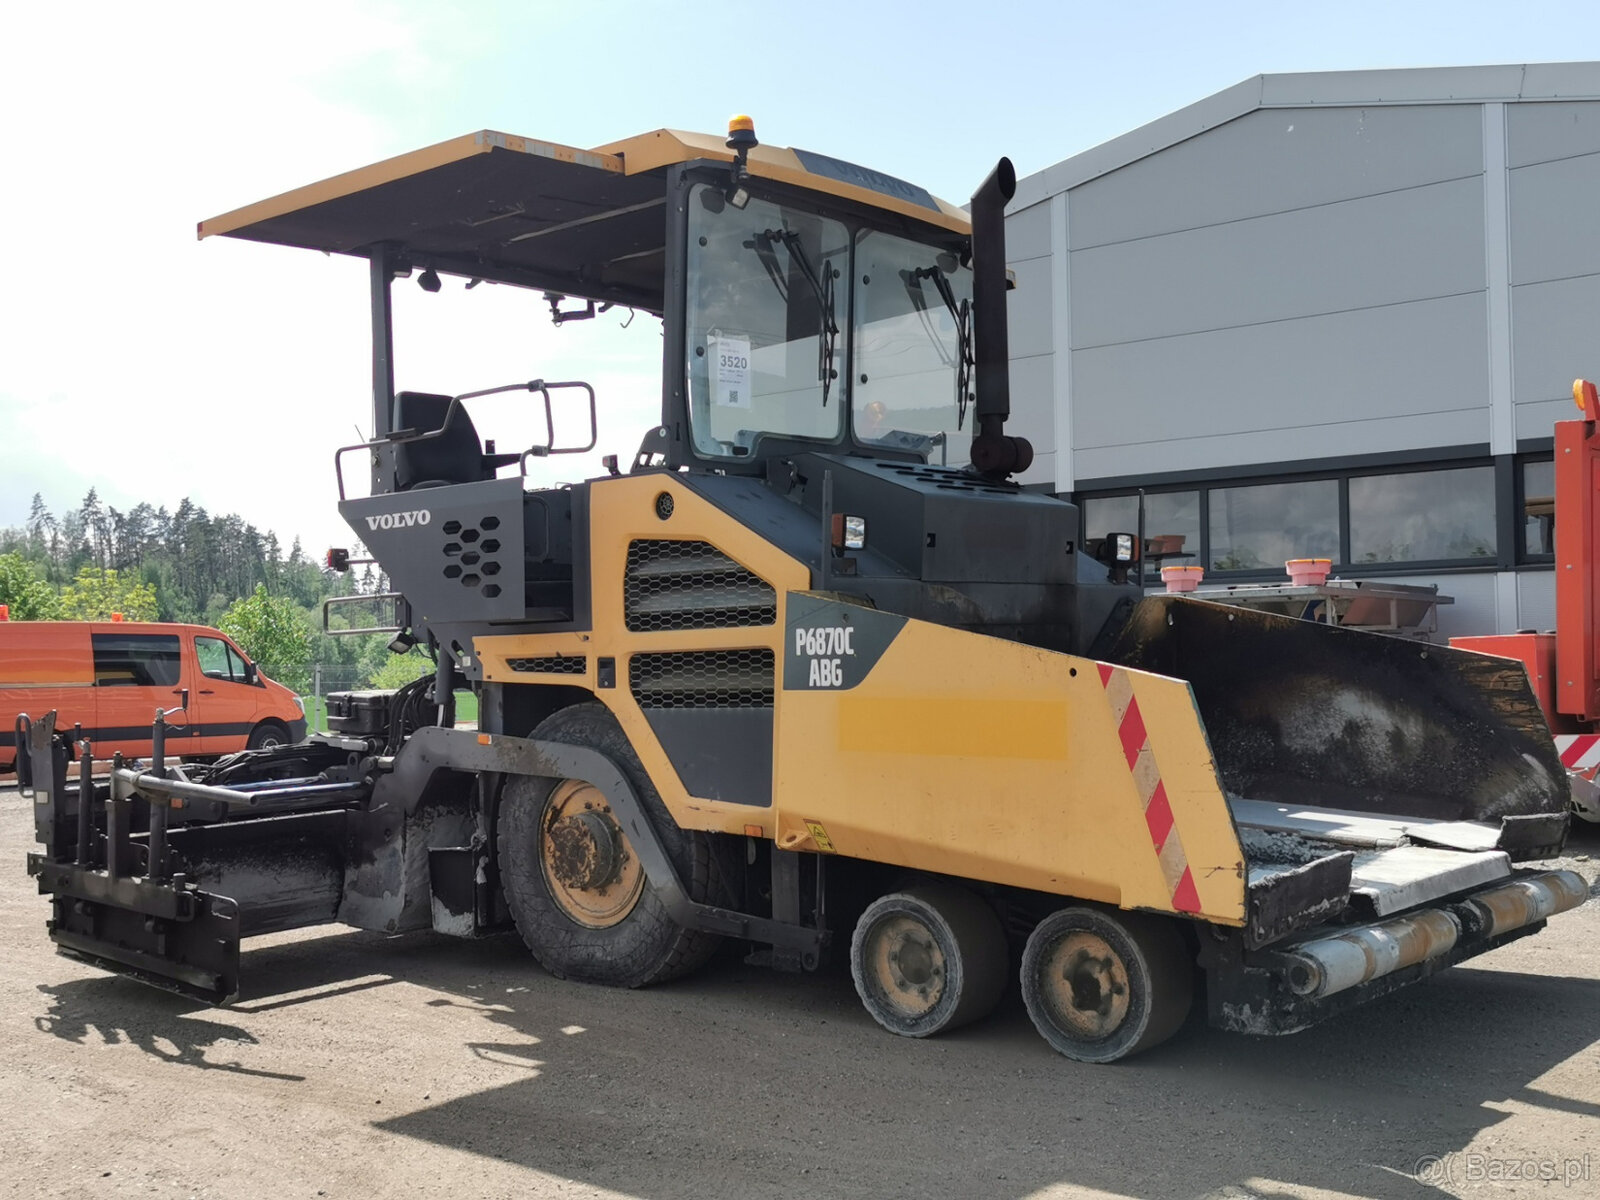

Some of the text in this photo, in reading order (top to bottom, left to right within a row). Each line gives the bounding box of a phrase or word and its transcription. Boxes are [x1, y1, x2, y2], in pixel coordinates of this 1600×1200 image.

[720, 355, 748, 369] 3520
[365, 509, 431, 531] VOLVO
[795, 626, 855, 656] P6870C
[808, 658, 843, 687] ABG
